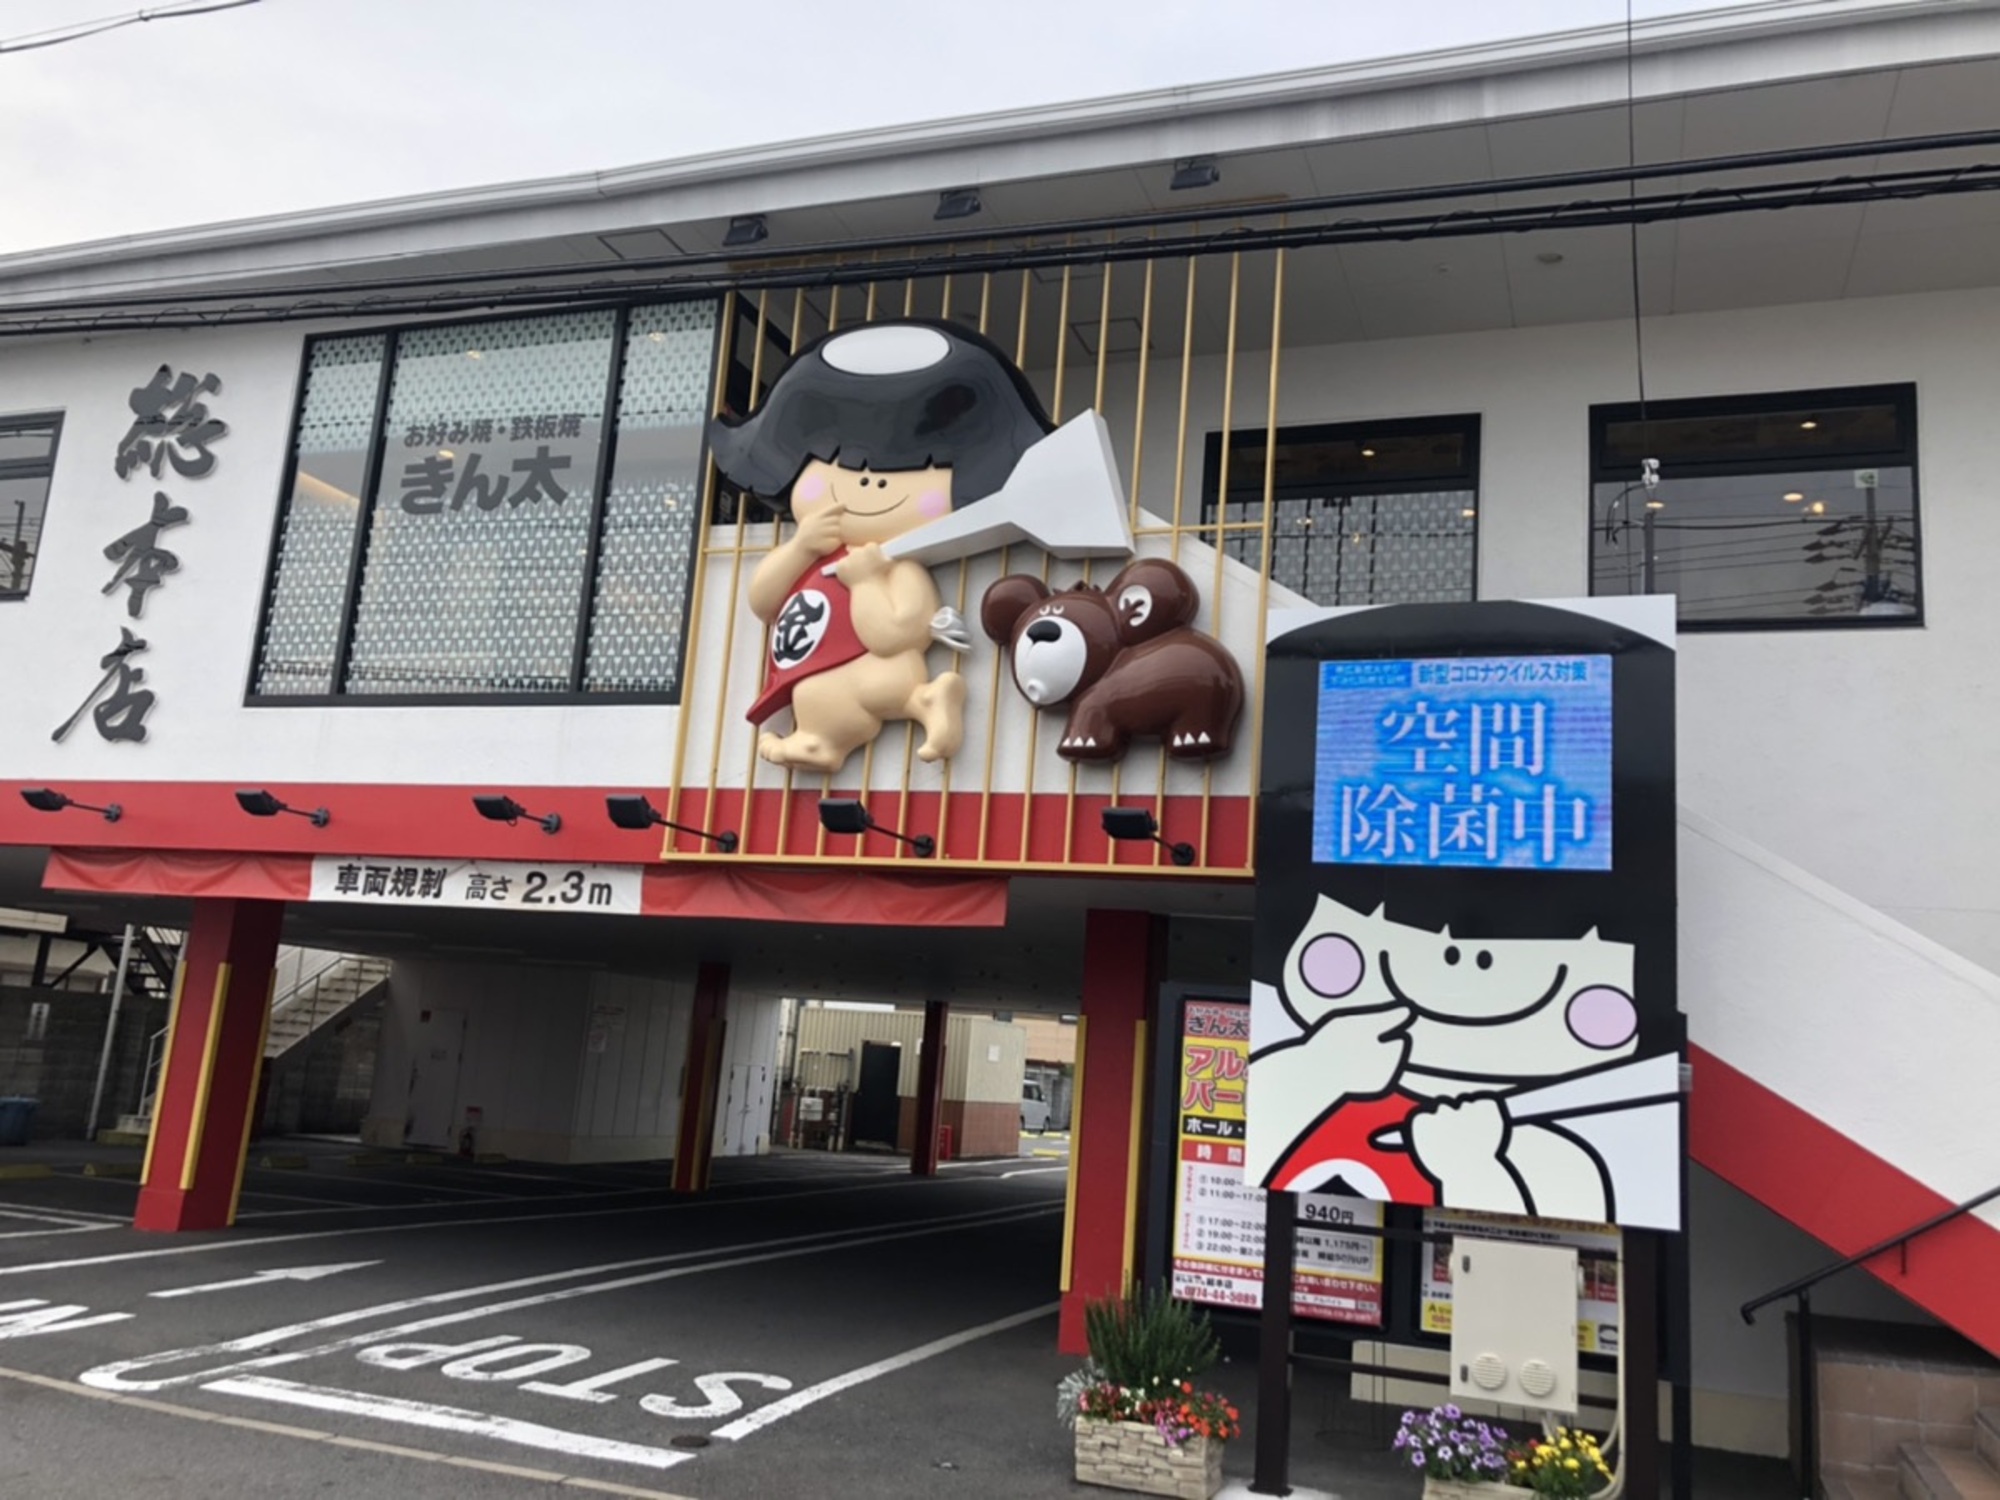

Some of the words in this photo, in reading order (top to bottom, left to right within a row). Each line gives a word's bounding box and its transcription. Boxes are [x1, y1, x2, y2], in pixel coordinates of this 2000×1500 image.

[404, 412, 582, 449] お好み焼・鉄板焼
[399, 445, 573, 515] きん太
[51, 363, 229, 744] 総本店
[1418, 661, 1588, 685] 新型コロナウイルス対策
[1381, 700, 1546, 777] 空間
[1340, 783, 1588, 864] 除菌中
[334, 863, 447, 900] 車両規制
[465, 872, 515, 903] 高さ
[521, 871, 613, 907] 2.3m
[1186, 1046, 1248, 1080] アル
[1305, 1203, 1354, 1224] 940円
[355, 1333, 794, 1420] STOP
